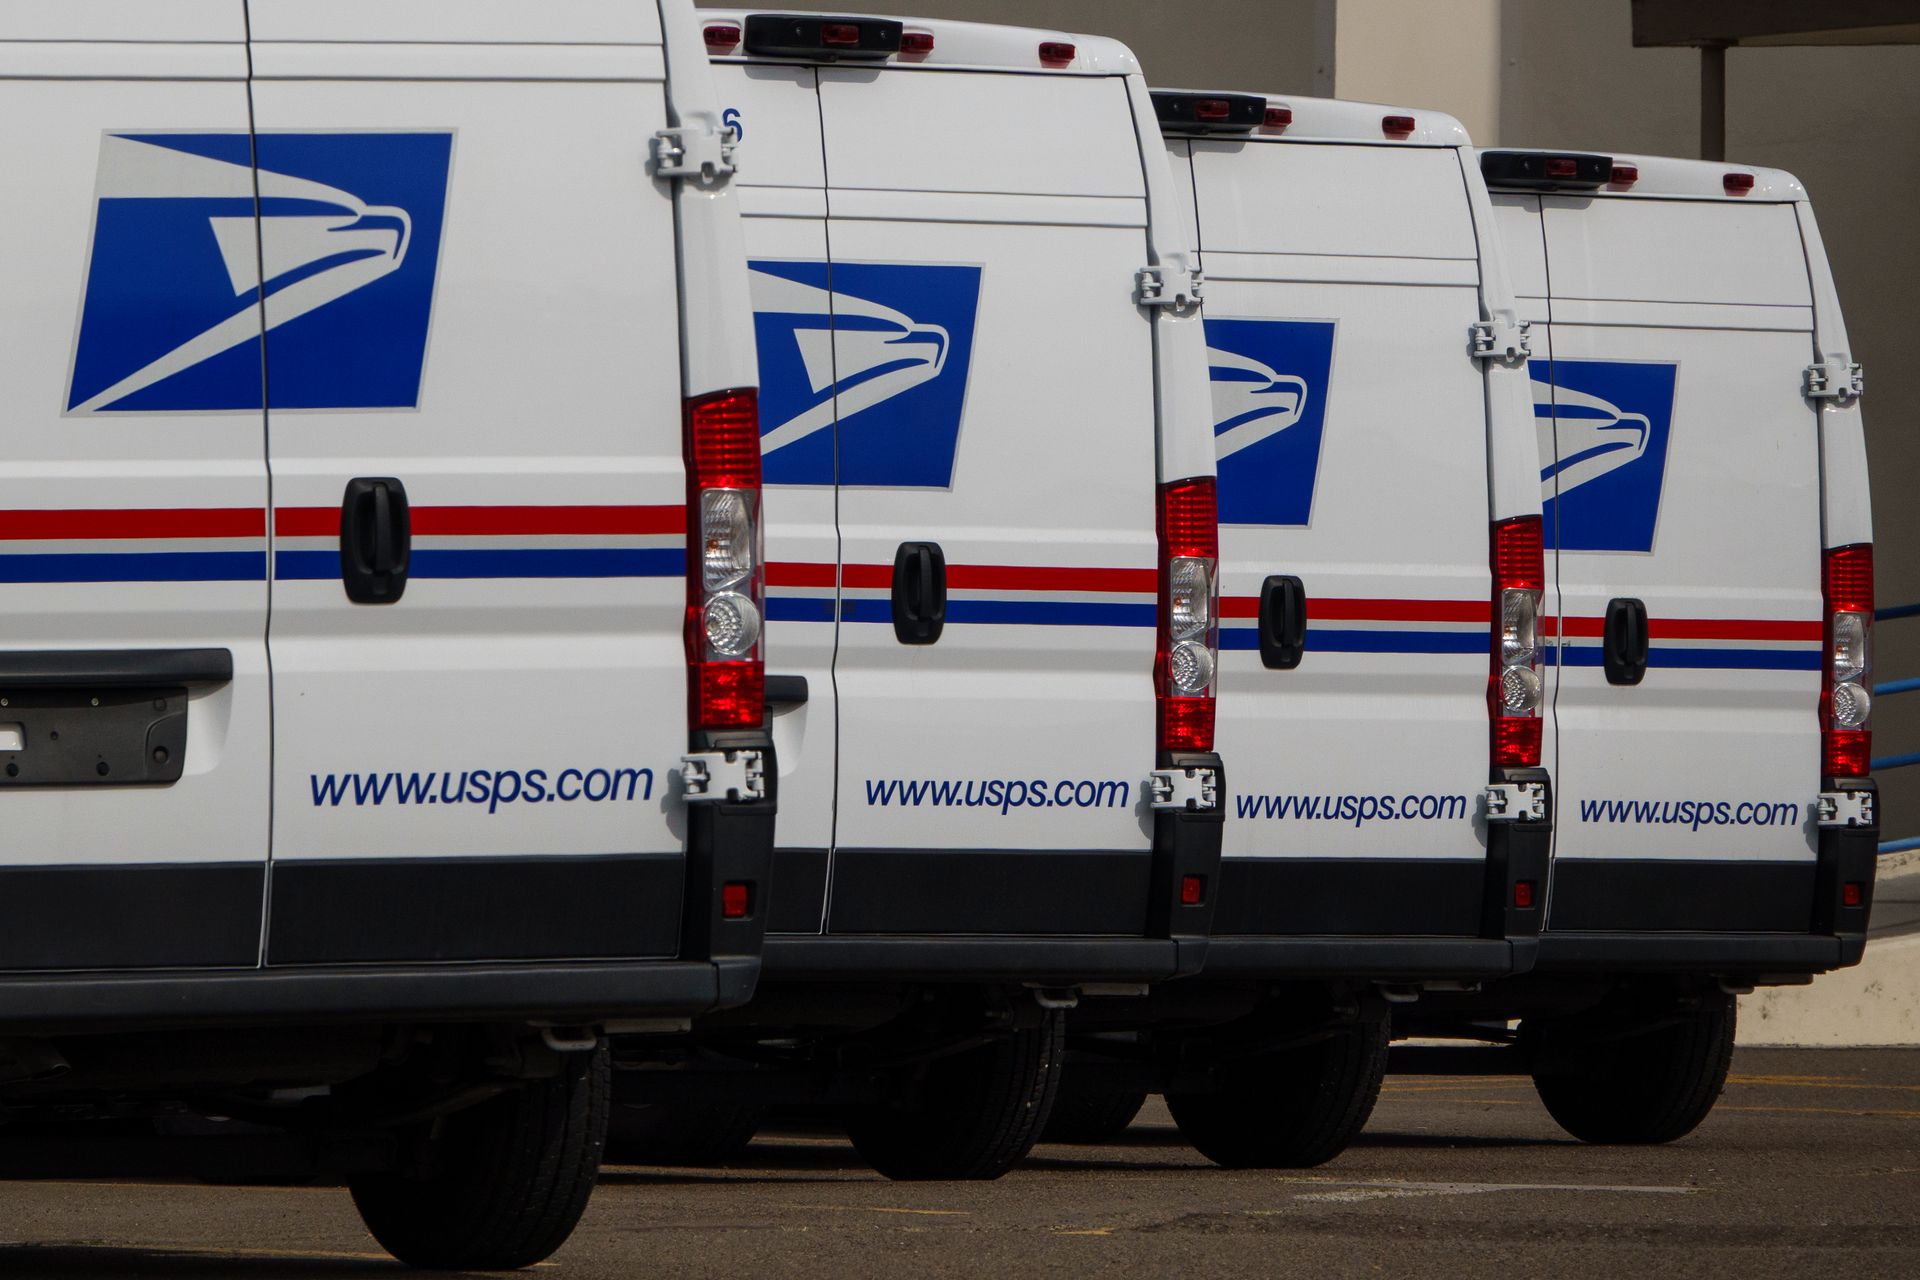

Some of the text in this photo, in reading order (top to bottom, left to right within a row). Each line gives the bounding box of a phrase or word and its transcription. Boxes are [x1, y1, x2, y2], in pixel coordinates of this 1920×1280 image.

[310, 766, 654, 815] www.usps.com
[866, 779, 1130, 815] www.usps.com
[1236, 795, 1467, 827] www.usps.com
[1580, 799, 1798, 832] www.usps.com
